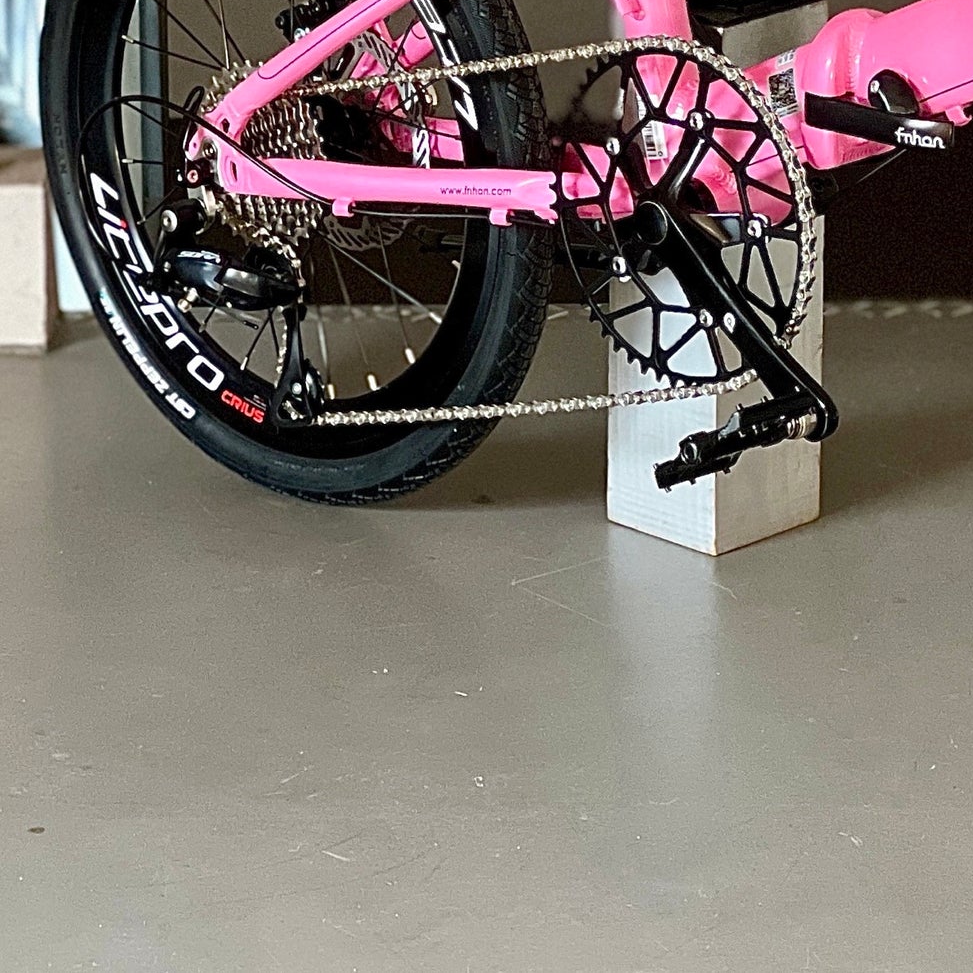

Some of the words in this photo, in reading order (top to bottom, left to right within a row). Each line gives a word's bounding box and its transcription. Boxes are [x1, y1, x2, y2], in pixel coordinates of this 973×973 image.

[895, 126, 946, 150] fnhon
[440, 185, 512, 196] www.fnhon.com
[221, 389, 266, 424] CRIUS
